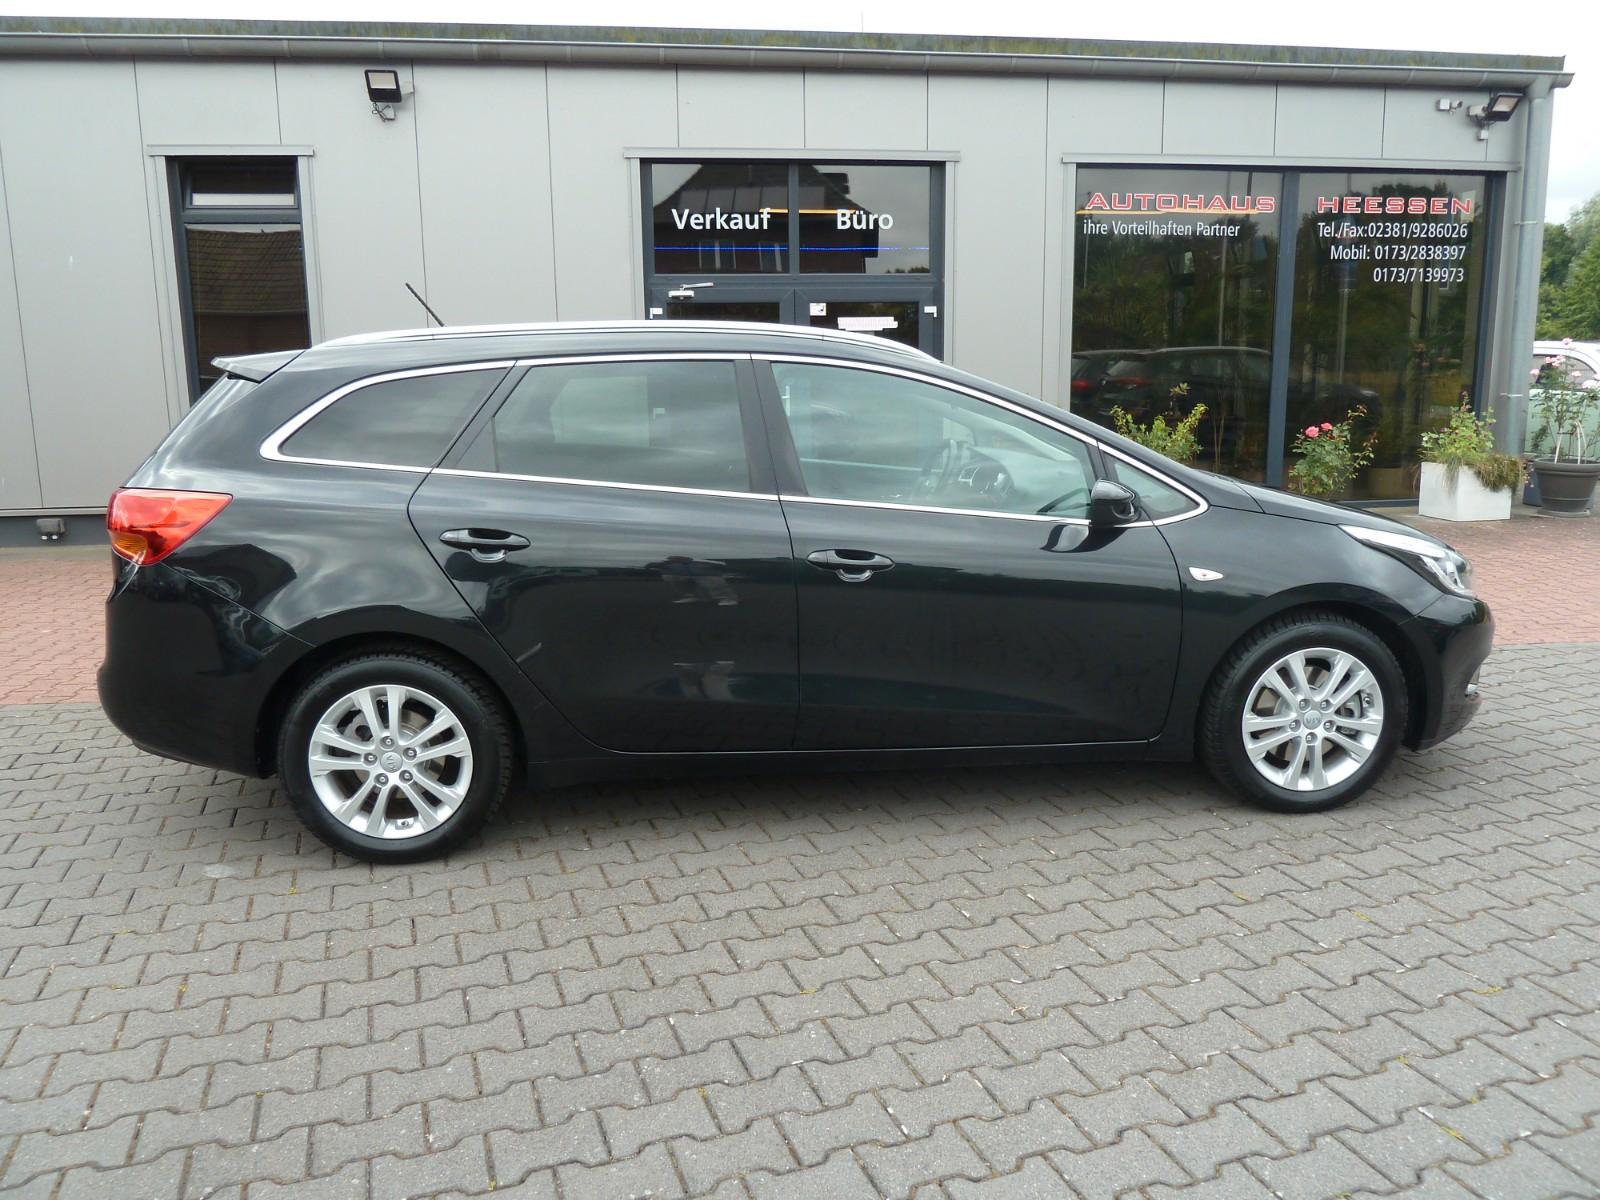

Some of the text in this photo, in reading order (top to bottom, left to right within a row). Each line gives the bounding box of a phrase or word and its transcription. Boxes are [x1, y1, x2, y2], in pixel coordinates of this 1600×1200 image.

[1085, 192, 1473, 215] AUTOHAUS HEESSEN
[671, 207, 771, 230] Verkauf
[836, 208, 894, 230] Büro
[1083, 219, 1241, 237] ihre Vorteilhaften Partner
[1317, 222, 1469, 239] Tel./Fax:02381/9286026
[1330, 244, 1466, 262] Mobil: 0173/2838397
[1373, 267, 1464, 284] 0173/7139973
